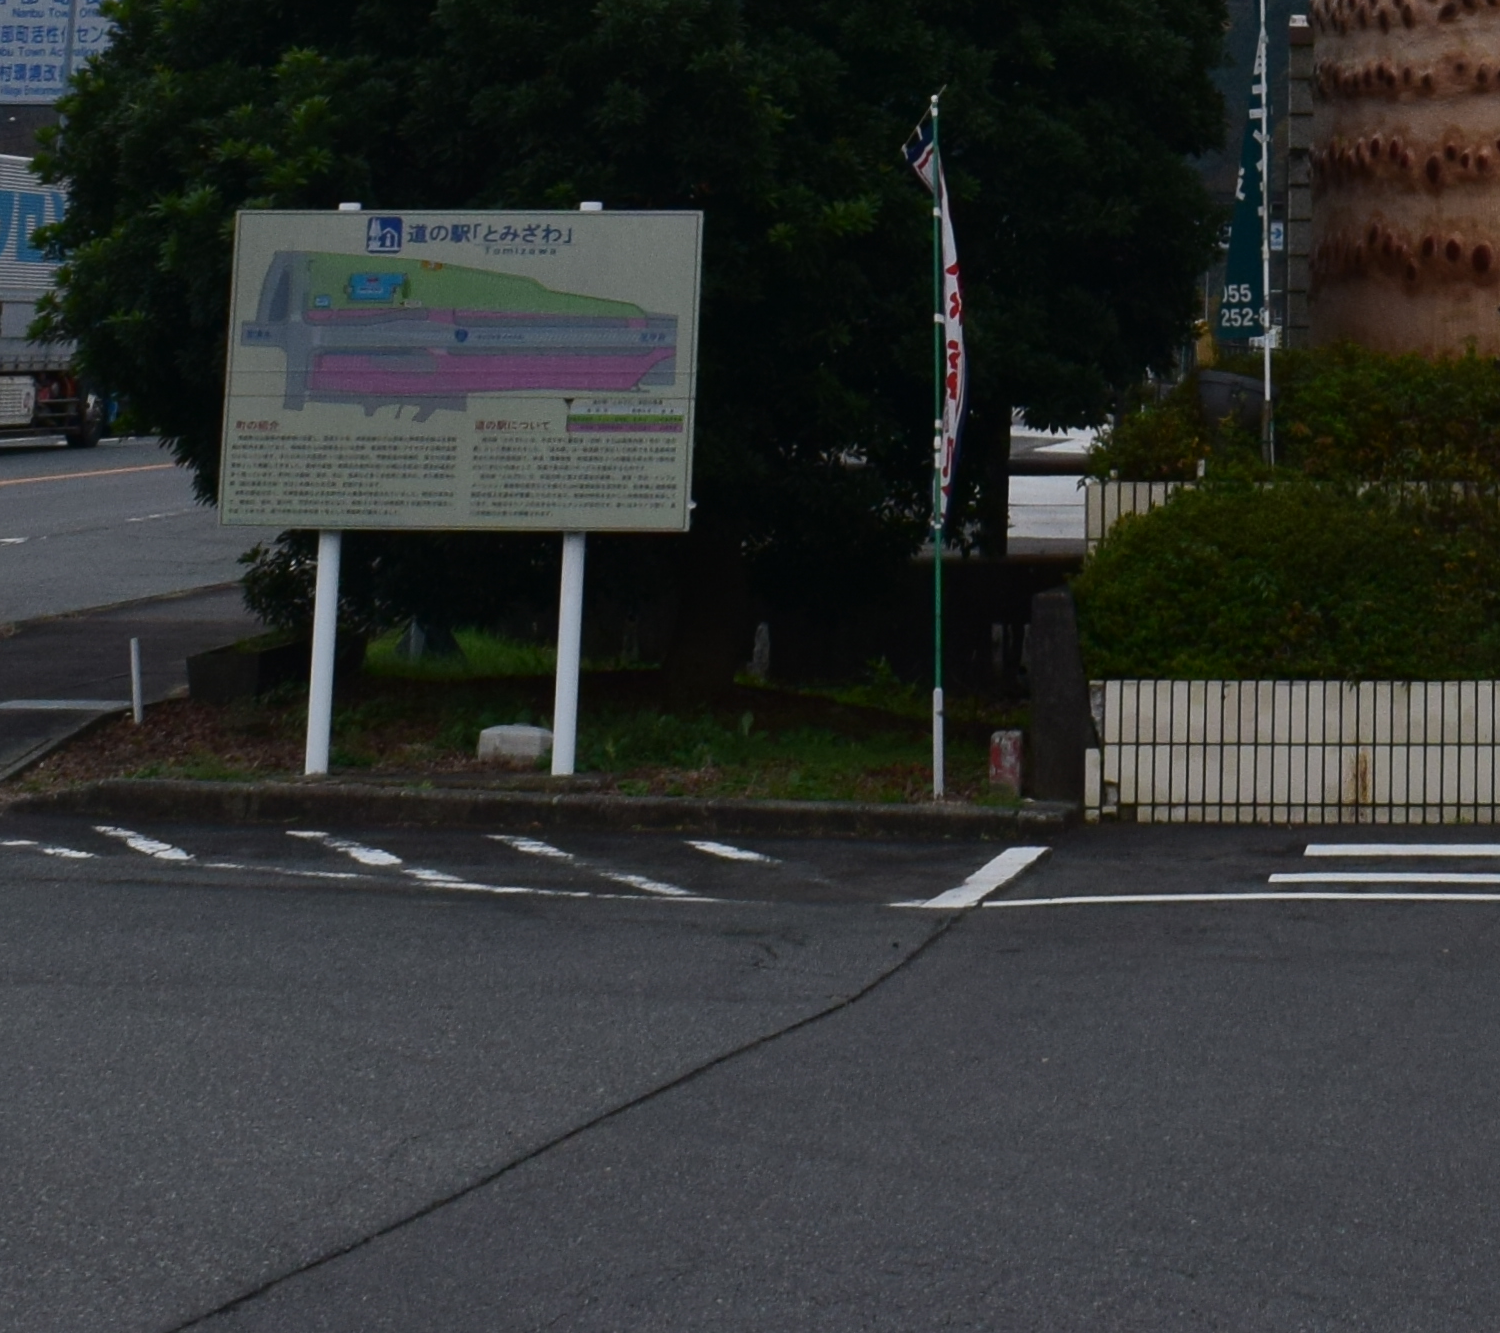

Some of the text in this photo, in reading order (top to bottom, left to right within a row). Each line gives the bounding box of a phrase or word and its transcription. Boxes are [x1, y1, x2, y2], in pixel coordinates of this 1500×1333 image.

[406, 221, 575, 245] 道の駅「とみざわ」
[484, 246, 558, 256] Tomizawa
[1222, 283, 1252, 303] 55
[235, 419, 280, 432] 町の紹介
[474, 420, 551, 431] 道の駅について
